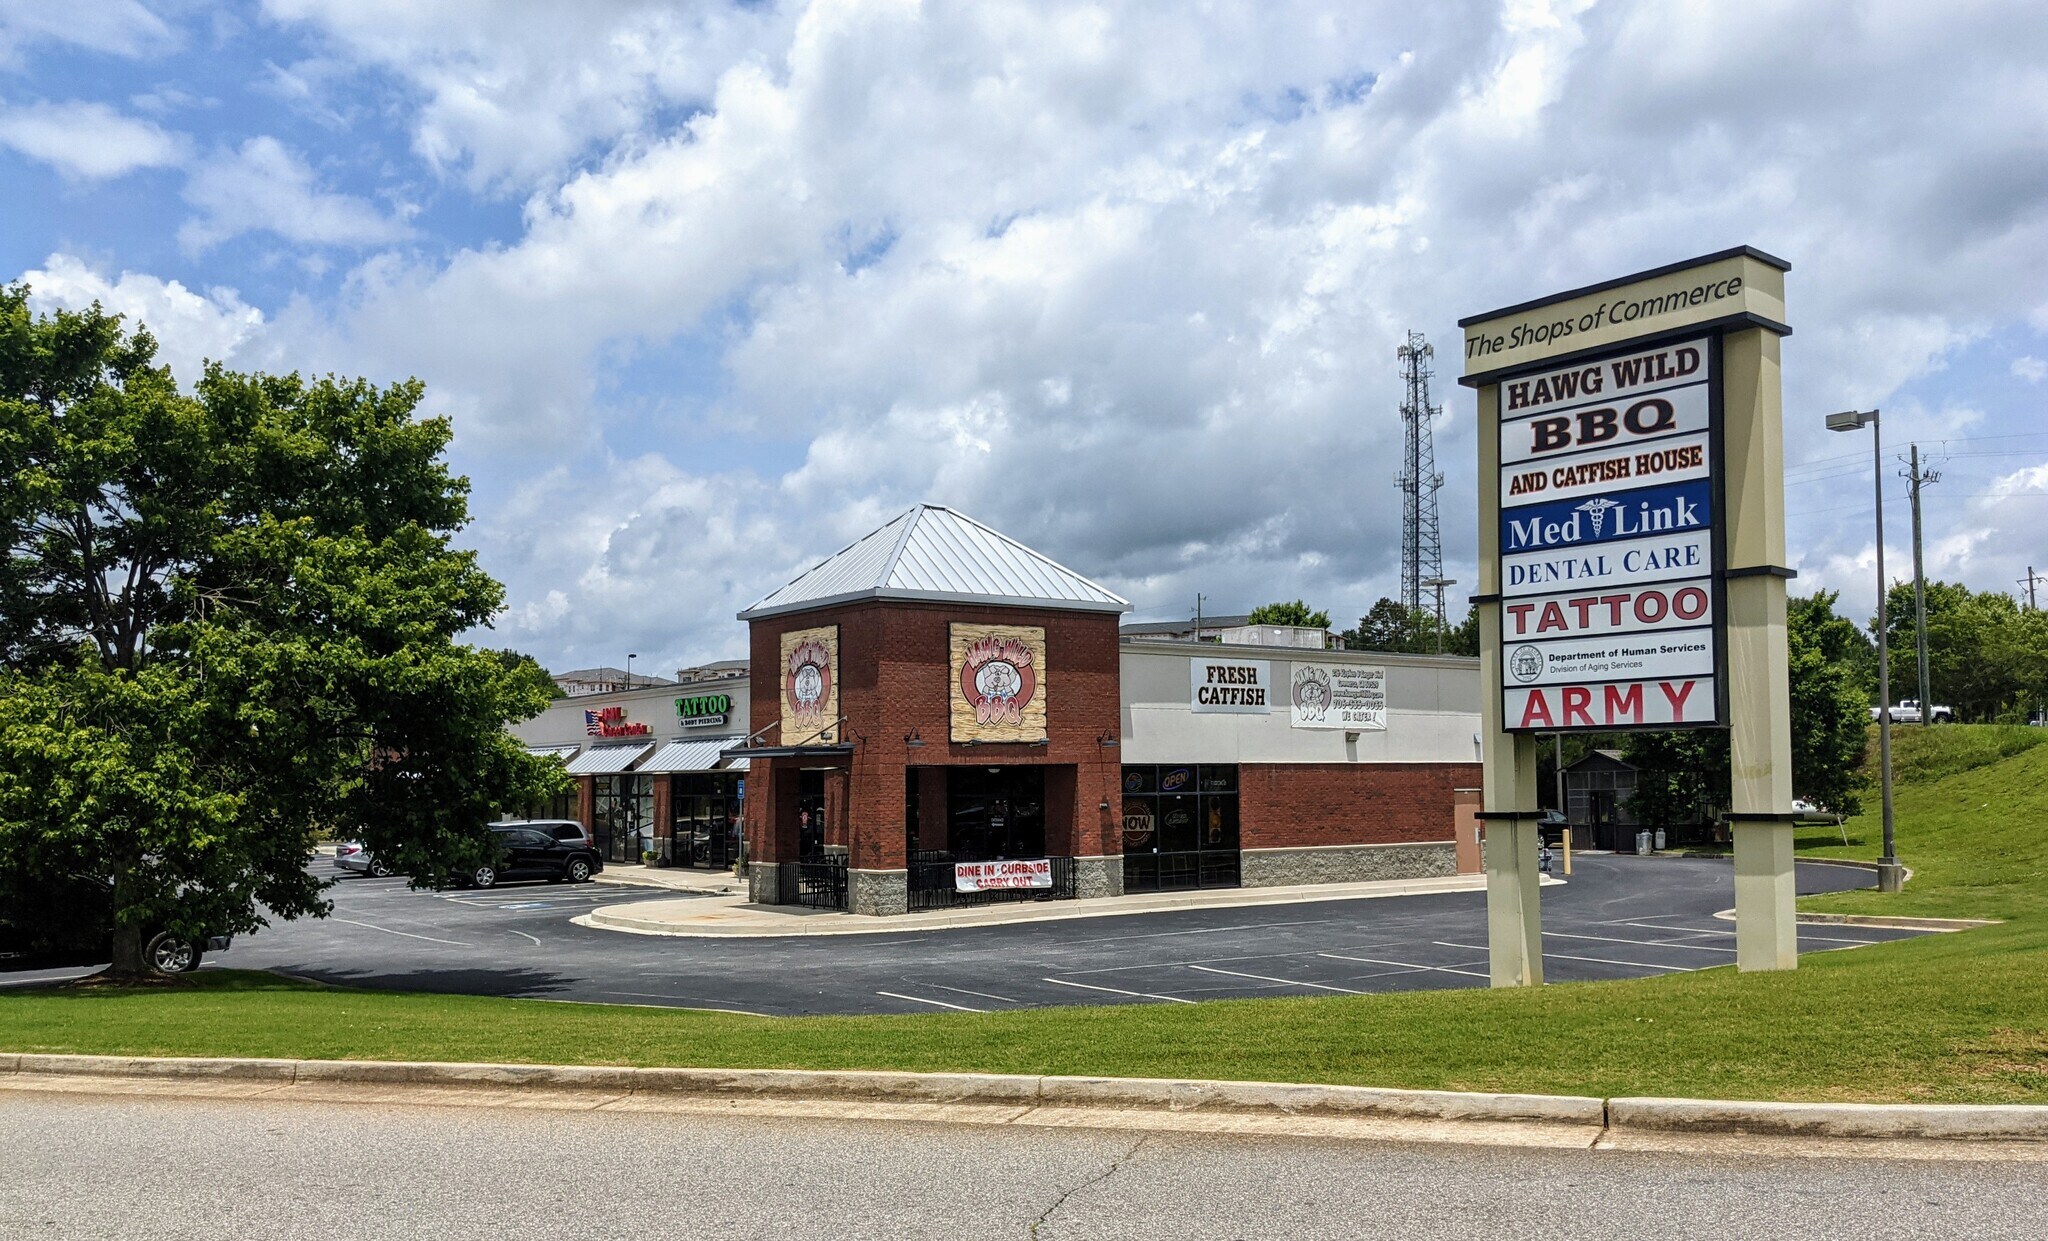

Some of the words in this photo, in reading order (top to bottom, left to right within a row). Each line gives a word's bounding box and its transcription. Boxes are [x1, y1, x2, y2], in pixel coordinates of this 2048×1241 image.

[1466, 335, 1504, 359] The
[1509, 318, 1573, 346] Shops
[1578, 304, 1605, 332] of
[1608, 276, 1742, 324] Commerce
[1507, 366, 1604, 411] HAWG
[1611, 346, 1700, 390] WILD
[1530, 398, 1677, 455] BBQ
[1509, 471, 1548, 496] AND
[1552, 457, 1631, 489] CATFISH
[1635, 444, 1703, 476] HOUSE
[1508, 511, 1581, 549] Med
[1612, 496, 1700, 537] Link
[1508, 555, 1613, 587] DENTAL
[1623, 544, 1700, 573] CARE
[1506, 586, 1709, 635] TATTOO
[964, 633, 1000, 671] HAWG
[1002, 637, 1033, 669] WILD
[1549, 651, 1606, 666] Department
[1608, 648, 1619, 658] of
[1621, 646, 1657, 657] Human
[1660, 643, 1706, 654] Services
[1550, 663, 1577, 674] Division
[1578, 663, 1587, 672] of
[1588, 661, 1609, 673] Aging
[1610, 660, 1643, 670] Services
[1206, 665, 1258, 685] FRESH
[675, 695, 728, 717] TATTOO
[975, 694, 1022, 726] BBQ
[1198, 686, 1265, 706] CATFISH
[1520, 680, 1696, 728] ARMY
[794, 699, 824, 730] BBQ
[1300, 702, 1325, 722] BBQ
[1164, 772, 1187, 788] OPEN
[957, 865, 981, 878] DINE
[984, 864, 995, 876] IN
[1000, 862, 1049, 875] CURBSIDE
[976, 877, 1010, 889] CARRY
[1013, 876, 1033, 887] OUT
